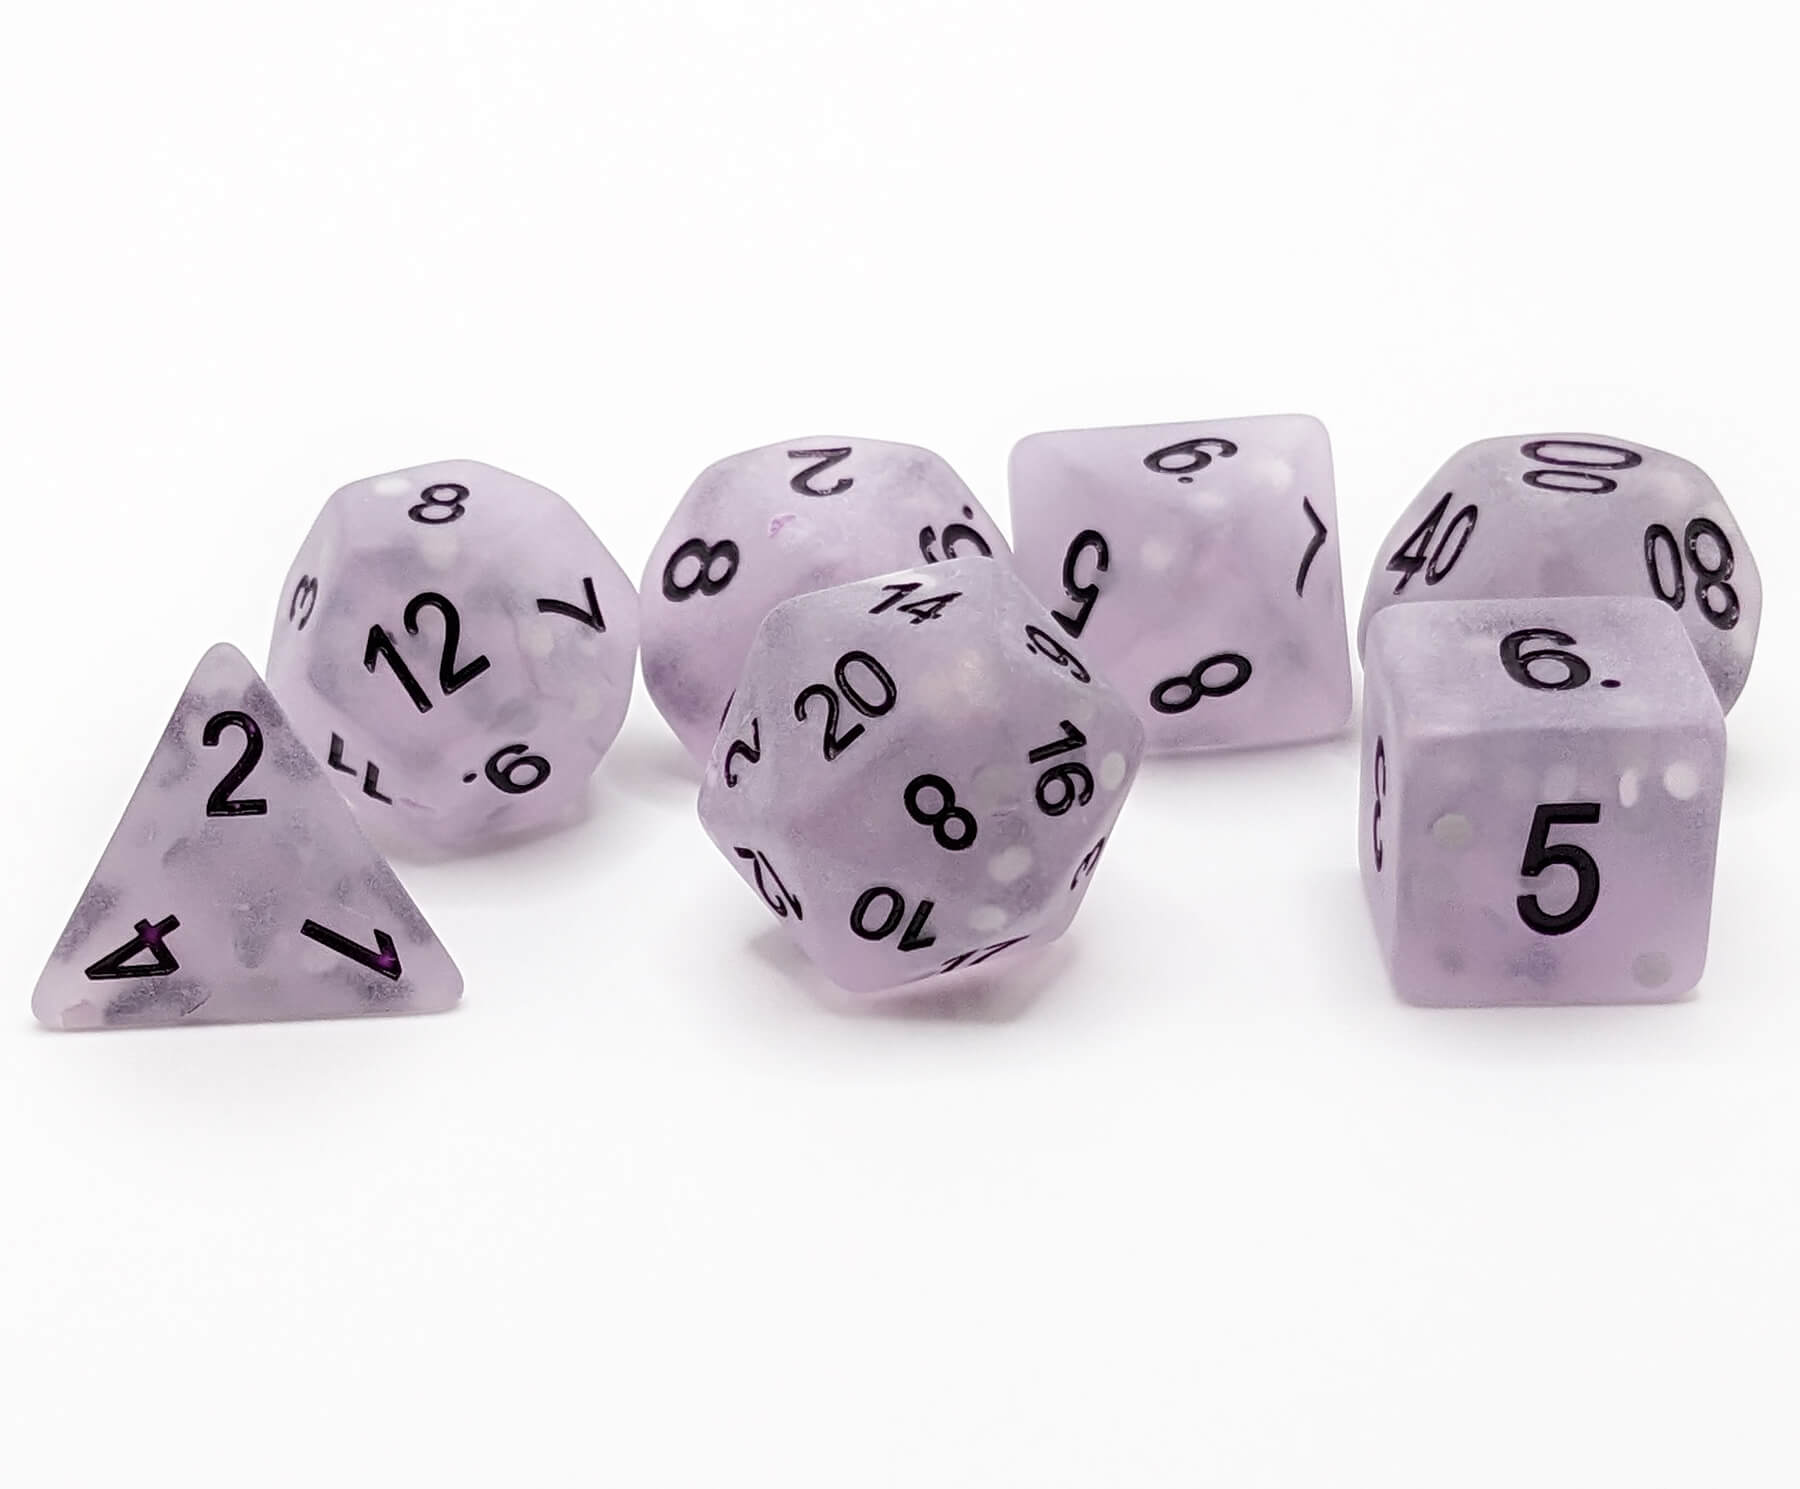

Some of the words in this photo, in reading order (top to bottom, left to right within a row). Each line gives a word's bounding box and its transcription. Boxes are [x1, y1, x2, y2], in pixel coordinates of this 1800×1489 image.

[787, 446, 855, 497] 2
[1520, 440, 1646, 495] 00
[409, 482, 470, 525] 8
[662, 537, 740, 602] 8
[1386, 492, 1479, 595] 40
[1644, 517, 1740, 631] 80
[289, 574, 318, 631] 3
[536, 576, 607, 632] 7
[868, 582, 964, 625] 14
[1050, 529, 1110, 639] 5
[363, 591, 492, 714] 12
[1149, 652, 1254, 714] 8
[793, 650, 898, 762] 20
[202, 710, 268, 818] 2
[724, 717, 761, 789] 2
[1028, 719, 1095, 817] 16
[903, 773, 978, 852] 8
[732, 846, 804, 921] 12
[1515, 802, 1602, 937] 5
[84, 914, 181, 981] 4
[300, 918, 404, 982] 1
[849, 885, 937, 953] 10
